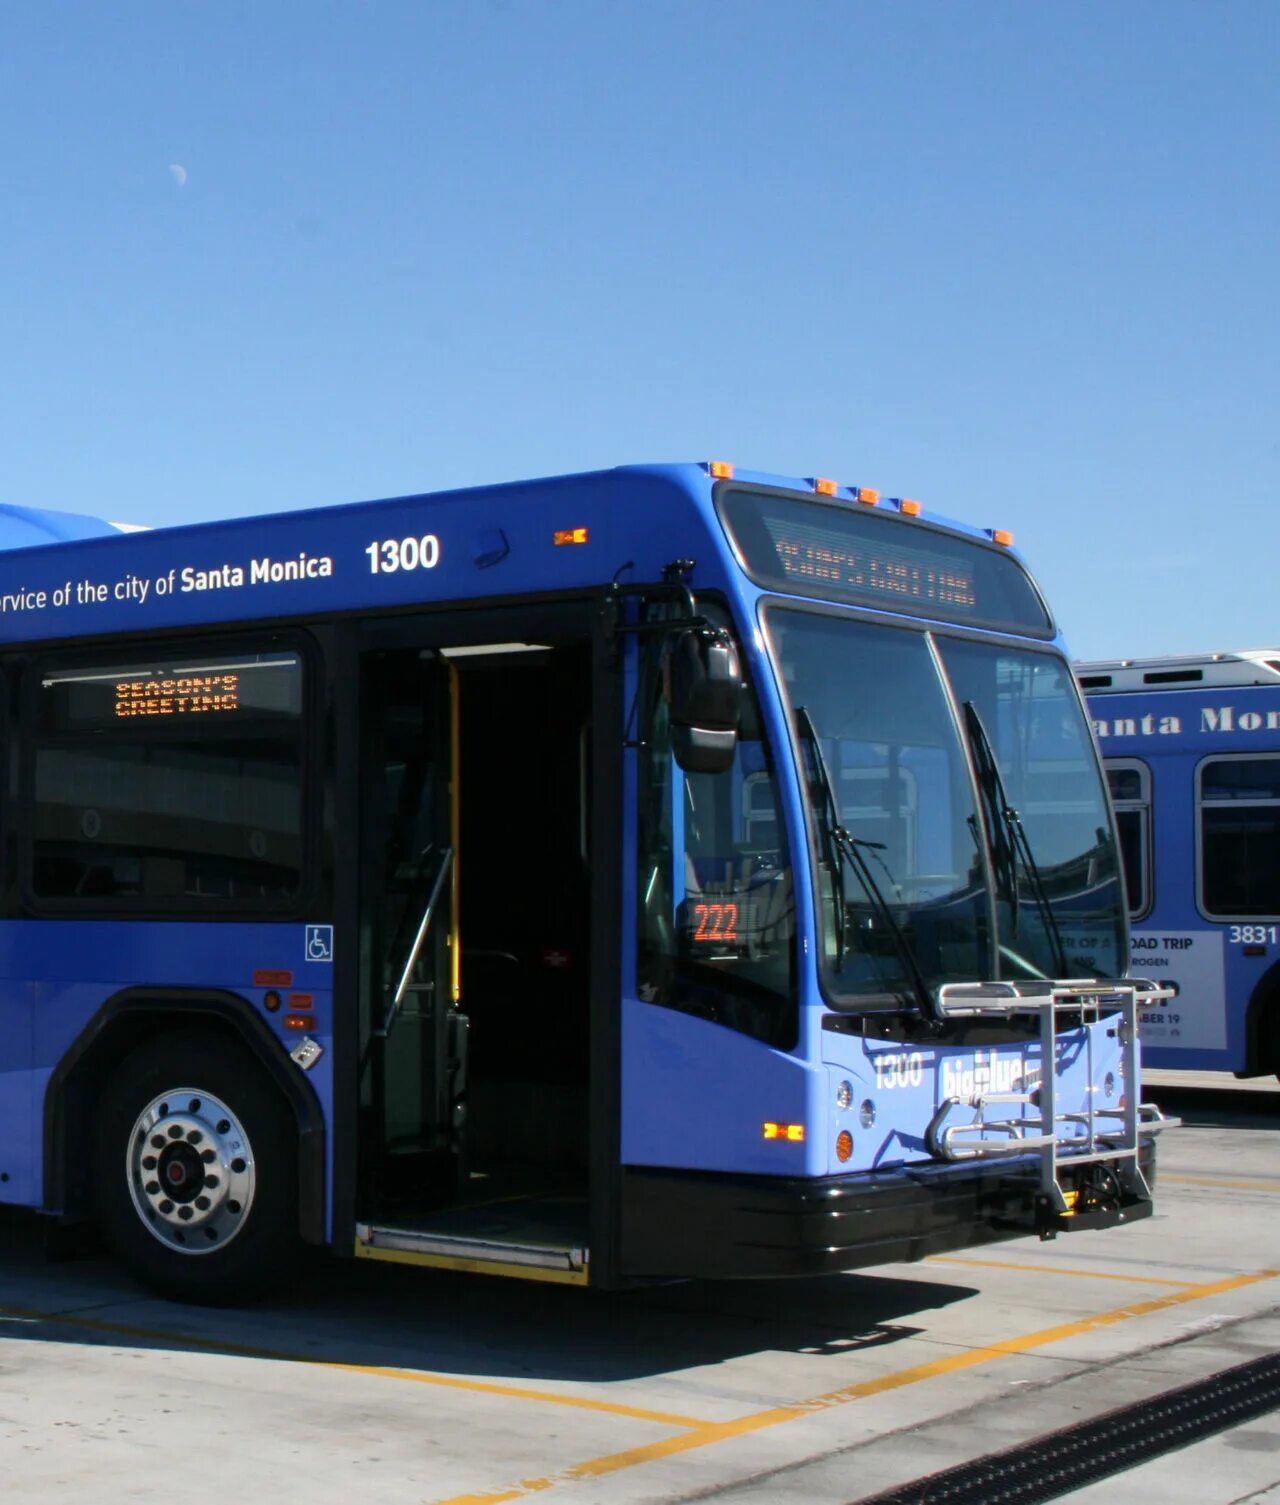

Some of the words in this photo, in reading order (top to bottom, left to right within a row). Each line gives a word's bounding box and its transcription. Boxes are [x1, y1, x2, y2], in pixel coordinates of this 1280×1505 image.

[365, 534, 439, 575] 1300
[53, 584, 72, 607] of
[76, 577, 109, 604] the
[114, 574, 149, 604] city
[155, 570, 176, 594] of
[181, 565, 244, 593] Santa
[250, 552, 332, 584] Monica
[1091, 712, 1183, 738] anta
[695, 904, 737, 941] 222
[1229, 926, 1279, 944] 3831
[1162, 937, 1193, 950] TRIP
[1131, 957, 1169, 967] ROGEN
[1168, 1013, 1180, 1024] 19
[874, 1052, 923, 1090] 1300
